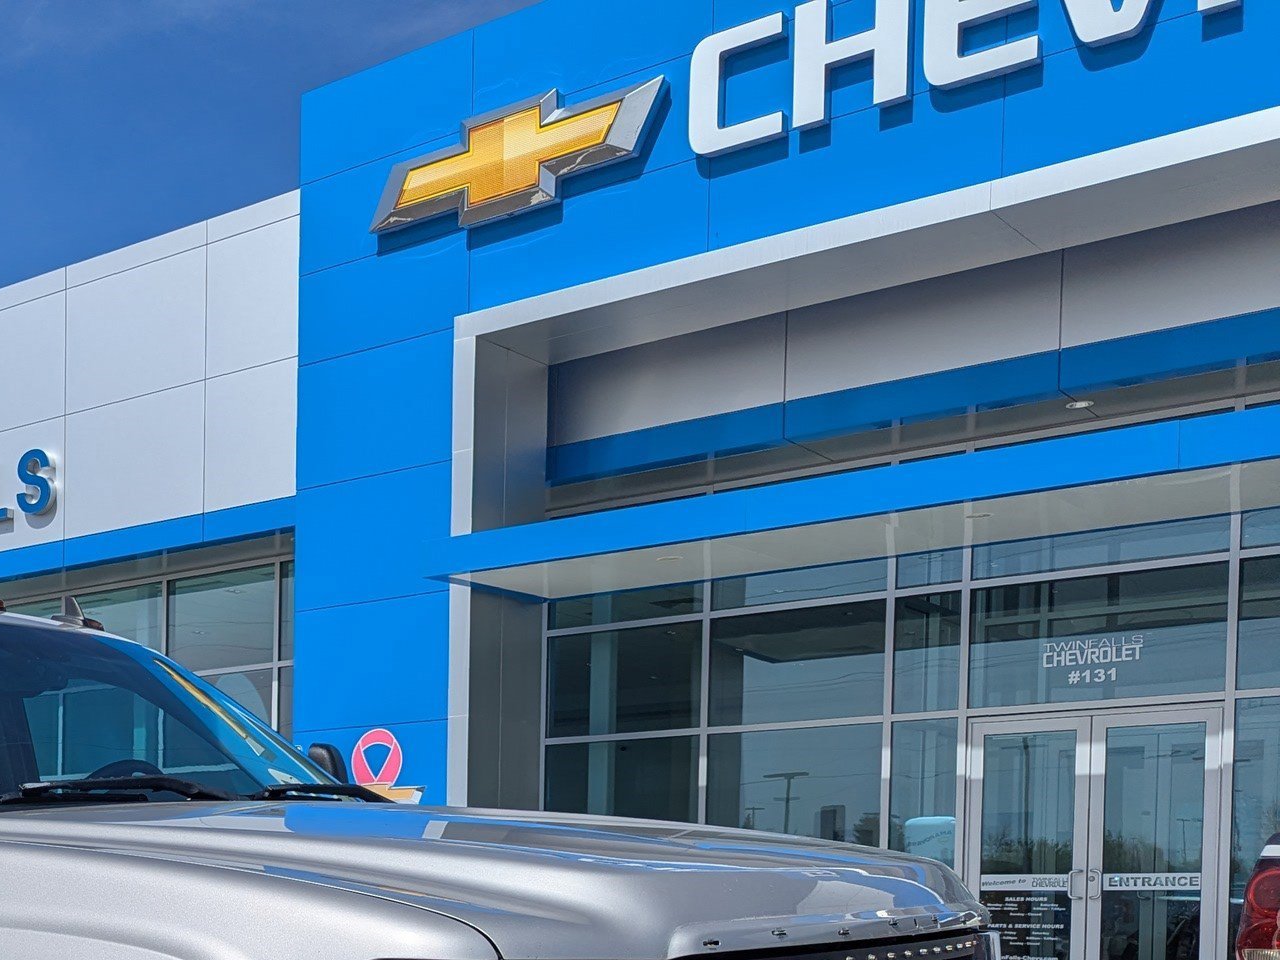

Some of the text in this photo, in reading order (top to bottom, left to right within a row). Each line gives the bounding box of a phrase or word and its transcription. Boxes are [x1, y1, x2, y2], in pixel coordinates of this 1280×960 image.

[688, 0, 1242, 158] CHE
[1042, 644, 1144, 668] CHEVROLET
[1068, 667, 1117, 685] #131
[1032, 880, 1068, 888] CHEVROLE
[1108, 876, 1200, 887] ENTRANCE
